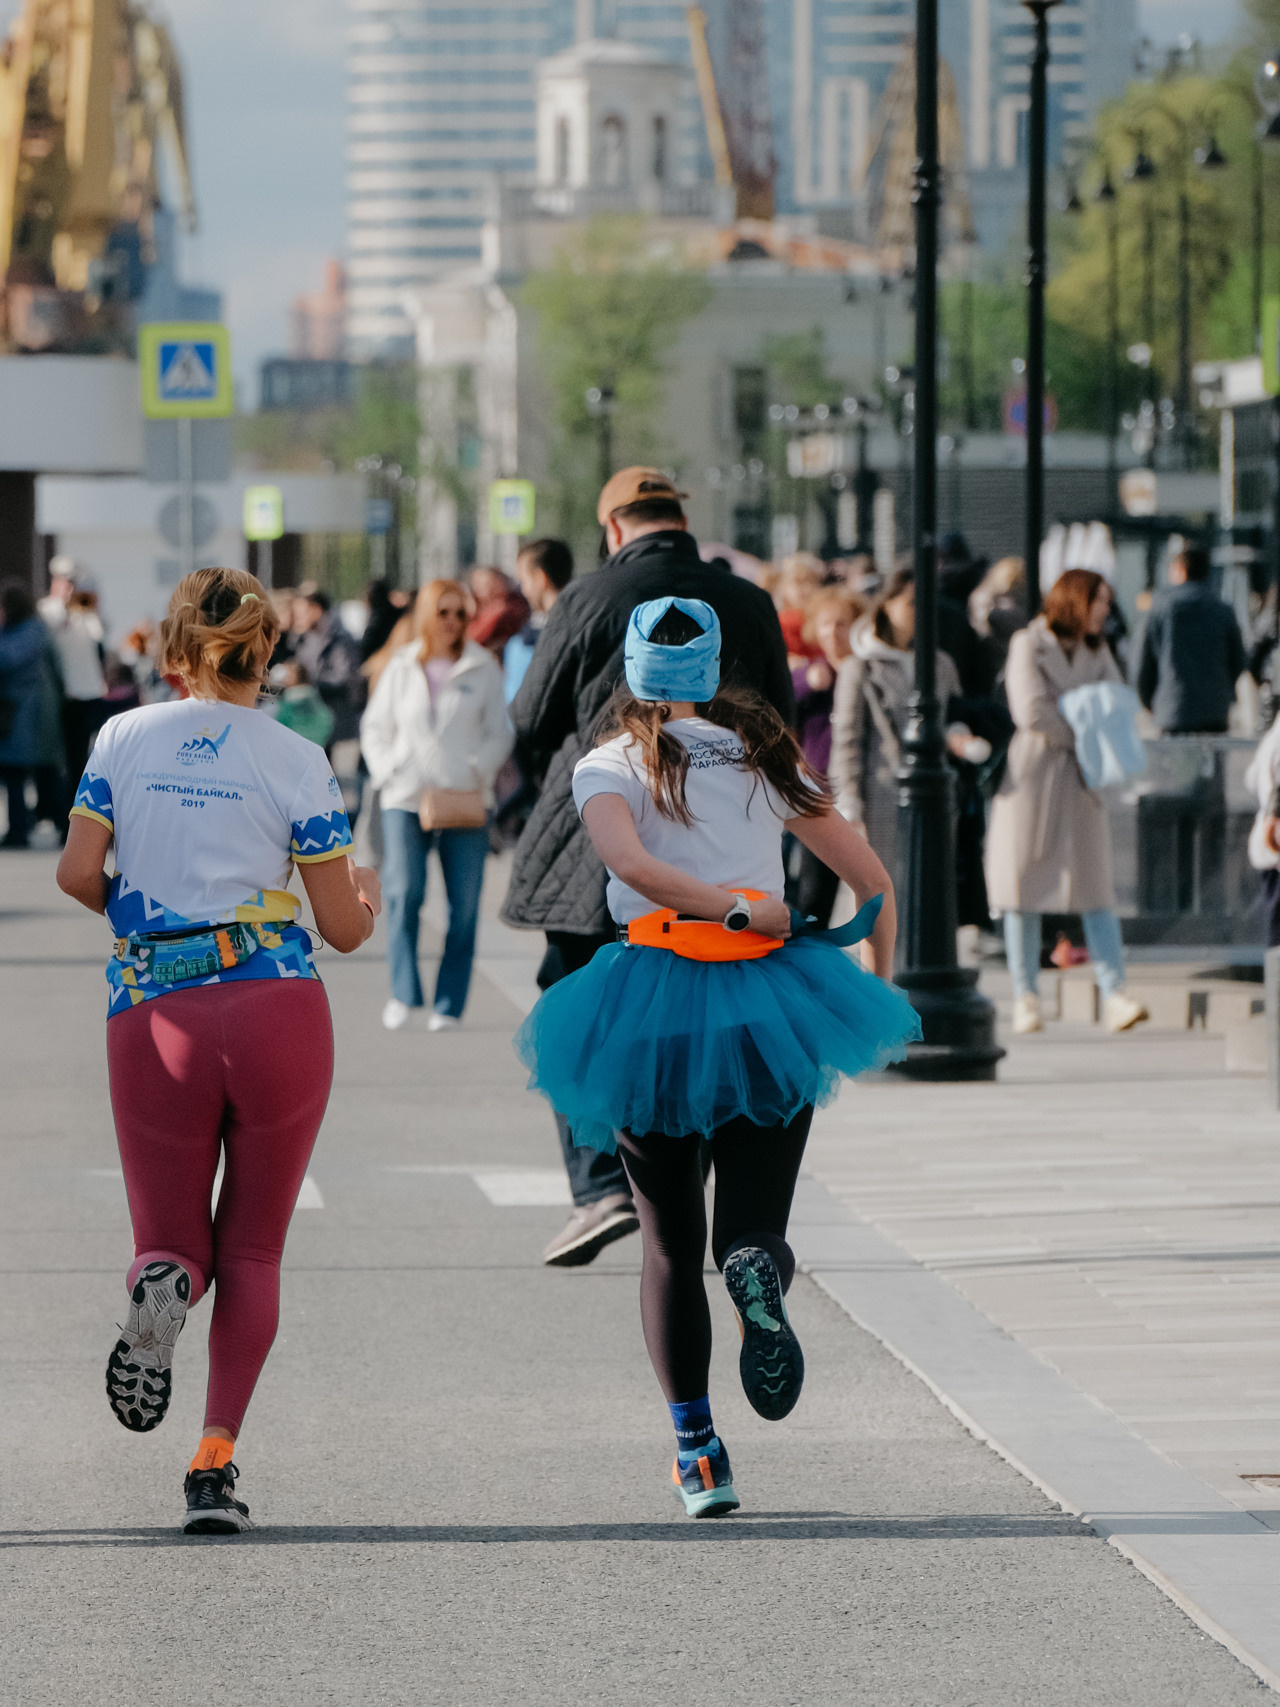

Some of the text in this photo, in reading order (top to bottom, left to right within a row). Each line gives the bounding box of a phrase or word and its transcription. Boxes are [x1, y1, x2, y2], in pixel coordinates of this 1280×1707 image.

[146, 784, 243, 801] «ЧИСТЫЙ БАЙКАЛ»
[181, 798, 205, 809] 2019
